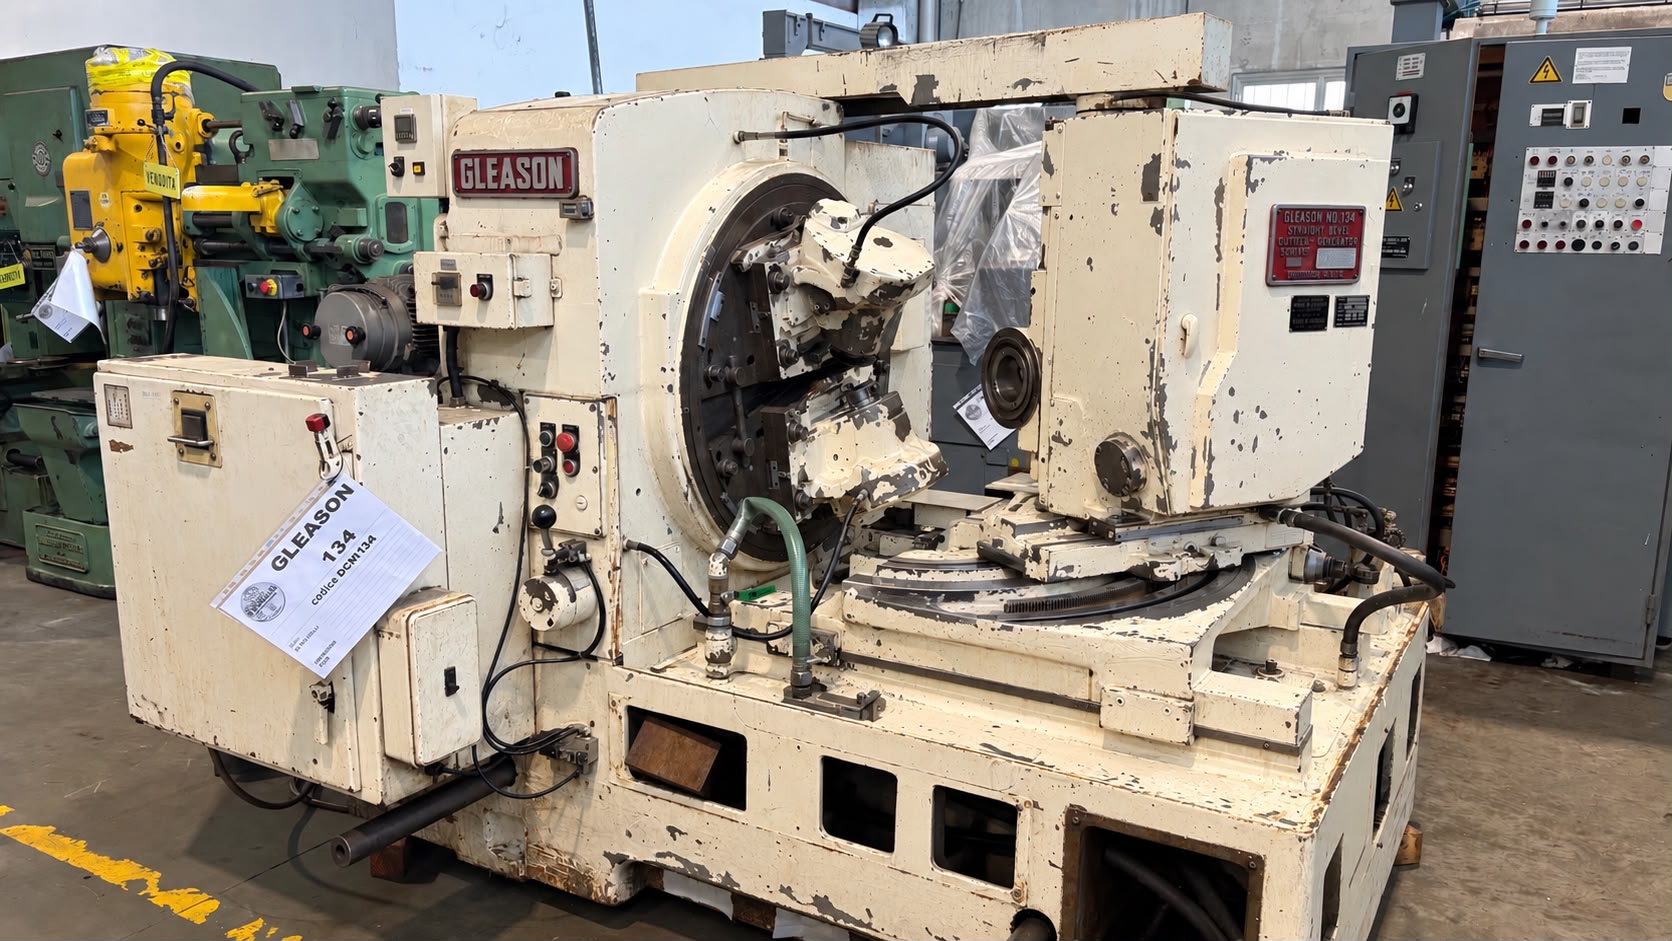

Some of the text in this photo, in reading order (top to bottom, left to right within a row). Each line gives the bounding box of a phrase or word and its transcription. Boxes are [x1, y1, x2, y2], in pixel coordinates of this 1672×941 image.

[460, 157, 563, 189] GLEASON
[1284, 211, 1322, 223] GLEASON
[270, 483, 354, 571] GLEASON
[322, 529, 356, 563] 134
[311, 576, 338, 605] codice
